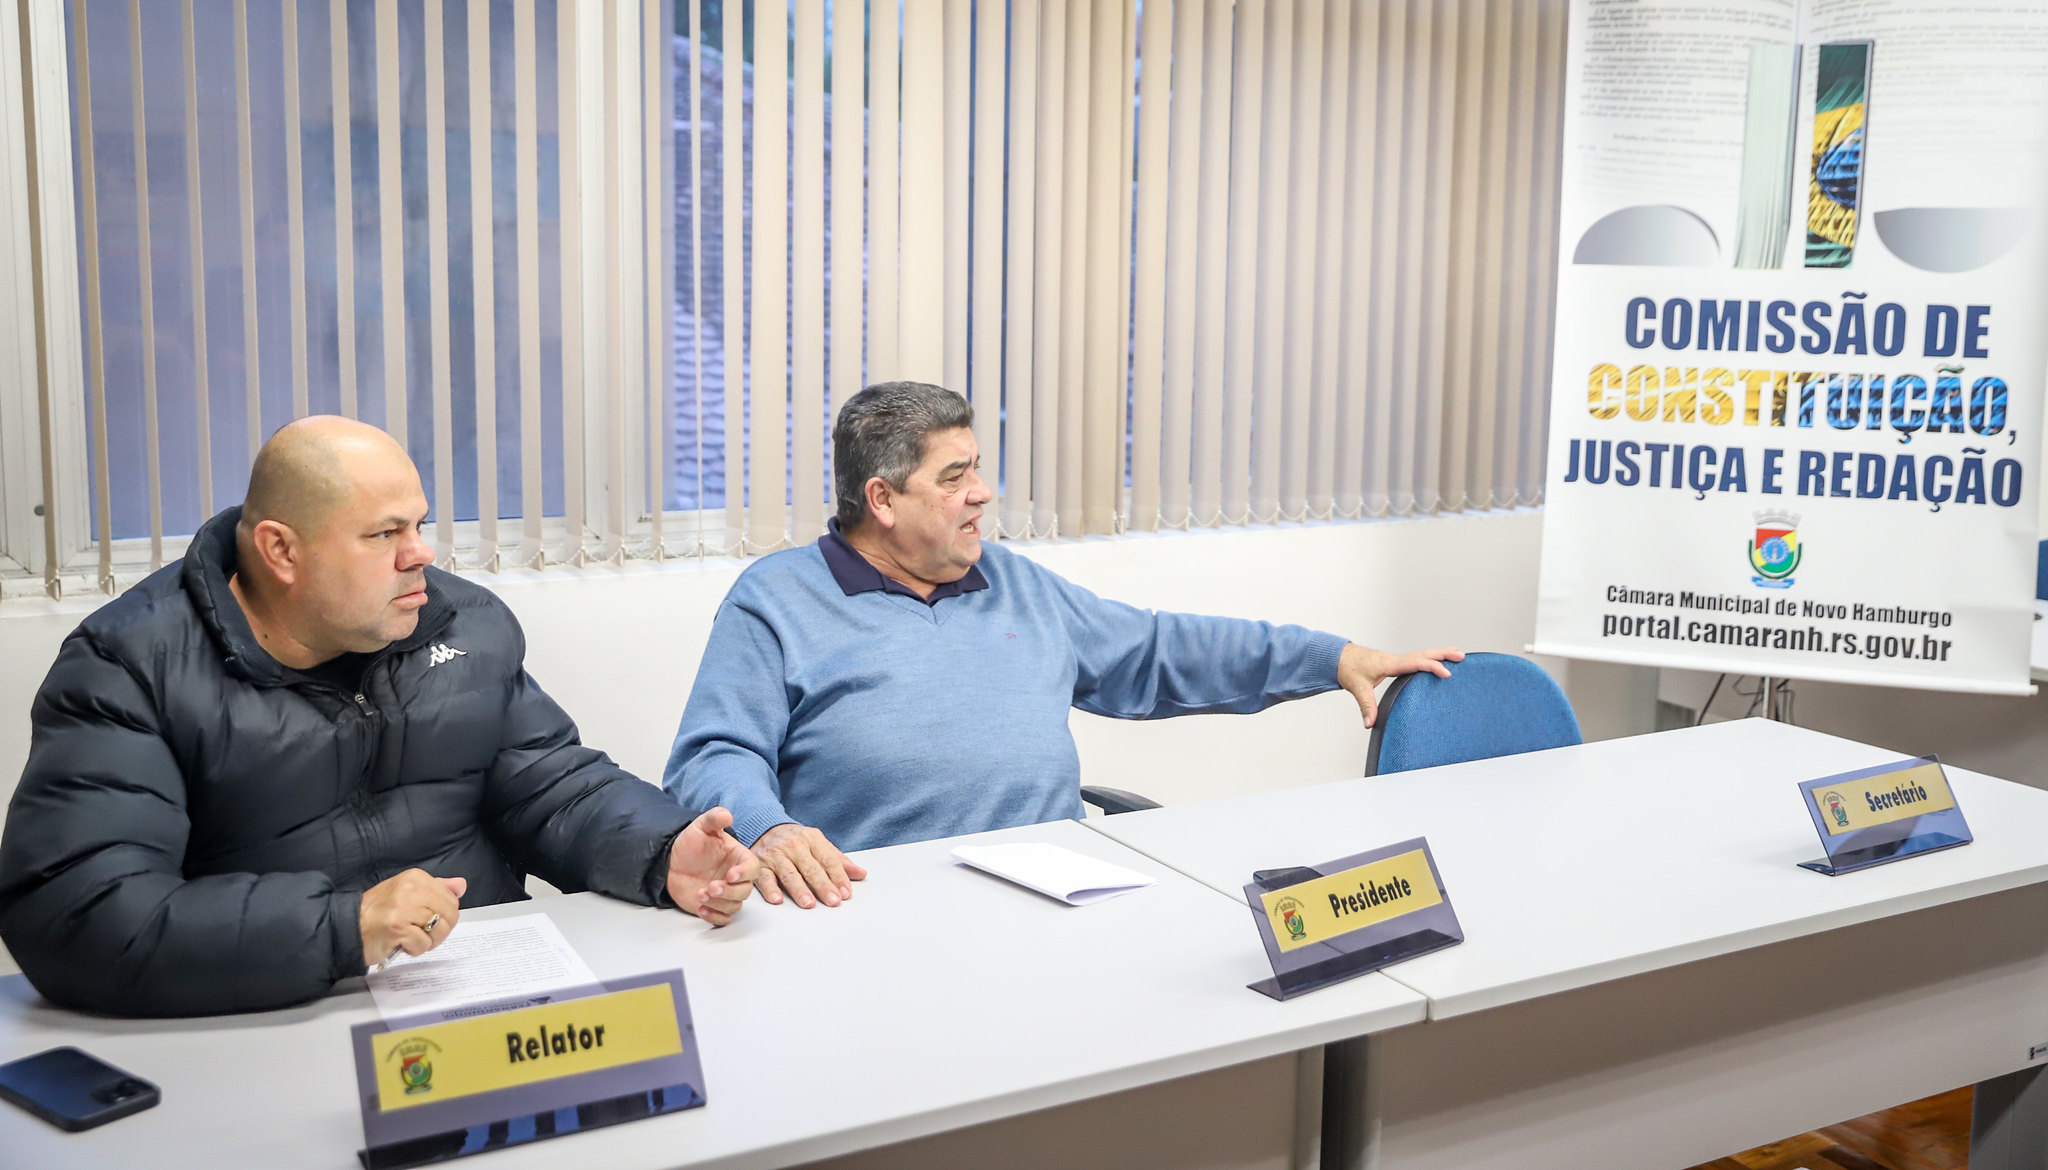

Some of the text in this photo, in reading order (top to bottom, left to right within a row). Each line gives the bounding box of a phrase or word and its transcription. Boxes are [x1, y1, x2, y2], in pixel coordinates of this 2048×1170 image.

[1625, 291, 1991, 358] COMISSÃO DE
[1587, 363, 2017, 446] CONSTITUIÇÃO,
[1564, 439, 2023, 513] JUSTIÇA E REDAÇÃO
[1606, 585, 1952, 628] Câmara Municipal de Novo Hamburgo
[1602, 613, 1952, 662] portal.camaranh.rs.gov.br
[1865, 780, 1927, 812] Secretário
[1328, 876, 1411, 918] Presidente
[507, 1023, 605, 1064] Relator
